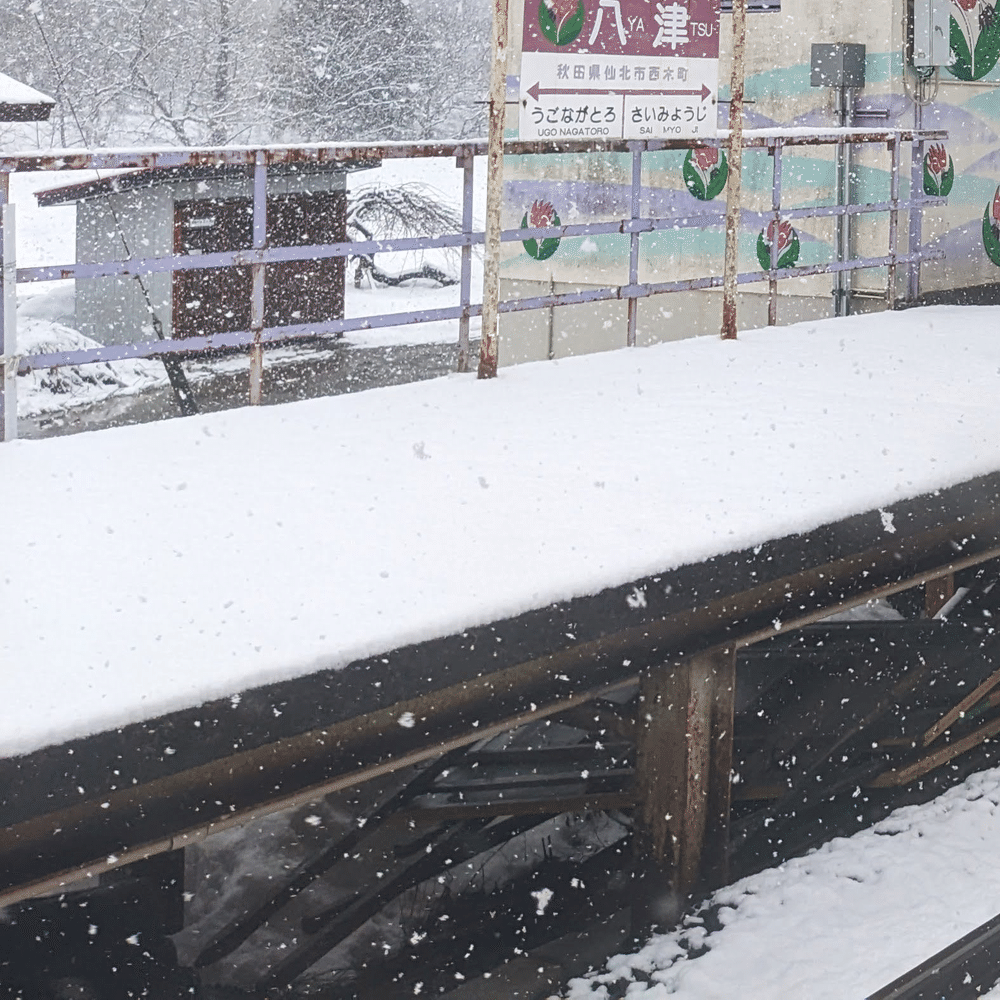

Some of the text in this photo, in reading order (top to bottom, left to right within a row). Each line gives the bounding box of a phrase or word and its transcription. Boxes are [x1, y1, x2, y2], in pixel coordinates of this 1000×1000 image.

[627, 15, 645, 33] YA
[689, 22, 713, 37] TSU
[556, 64, 689, 83] 秋田県仙北市西木町
[532, 106, 616, 125] うごながとろ
[631, 106, 707, 123] さいみょうじ
[538, 127, 609, 137] UGO NAGATORO
